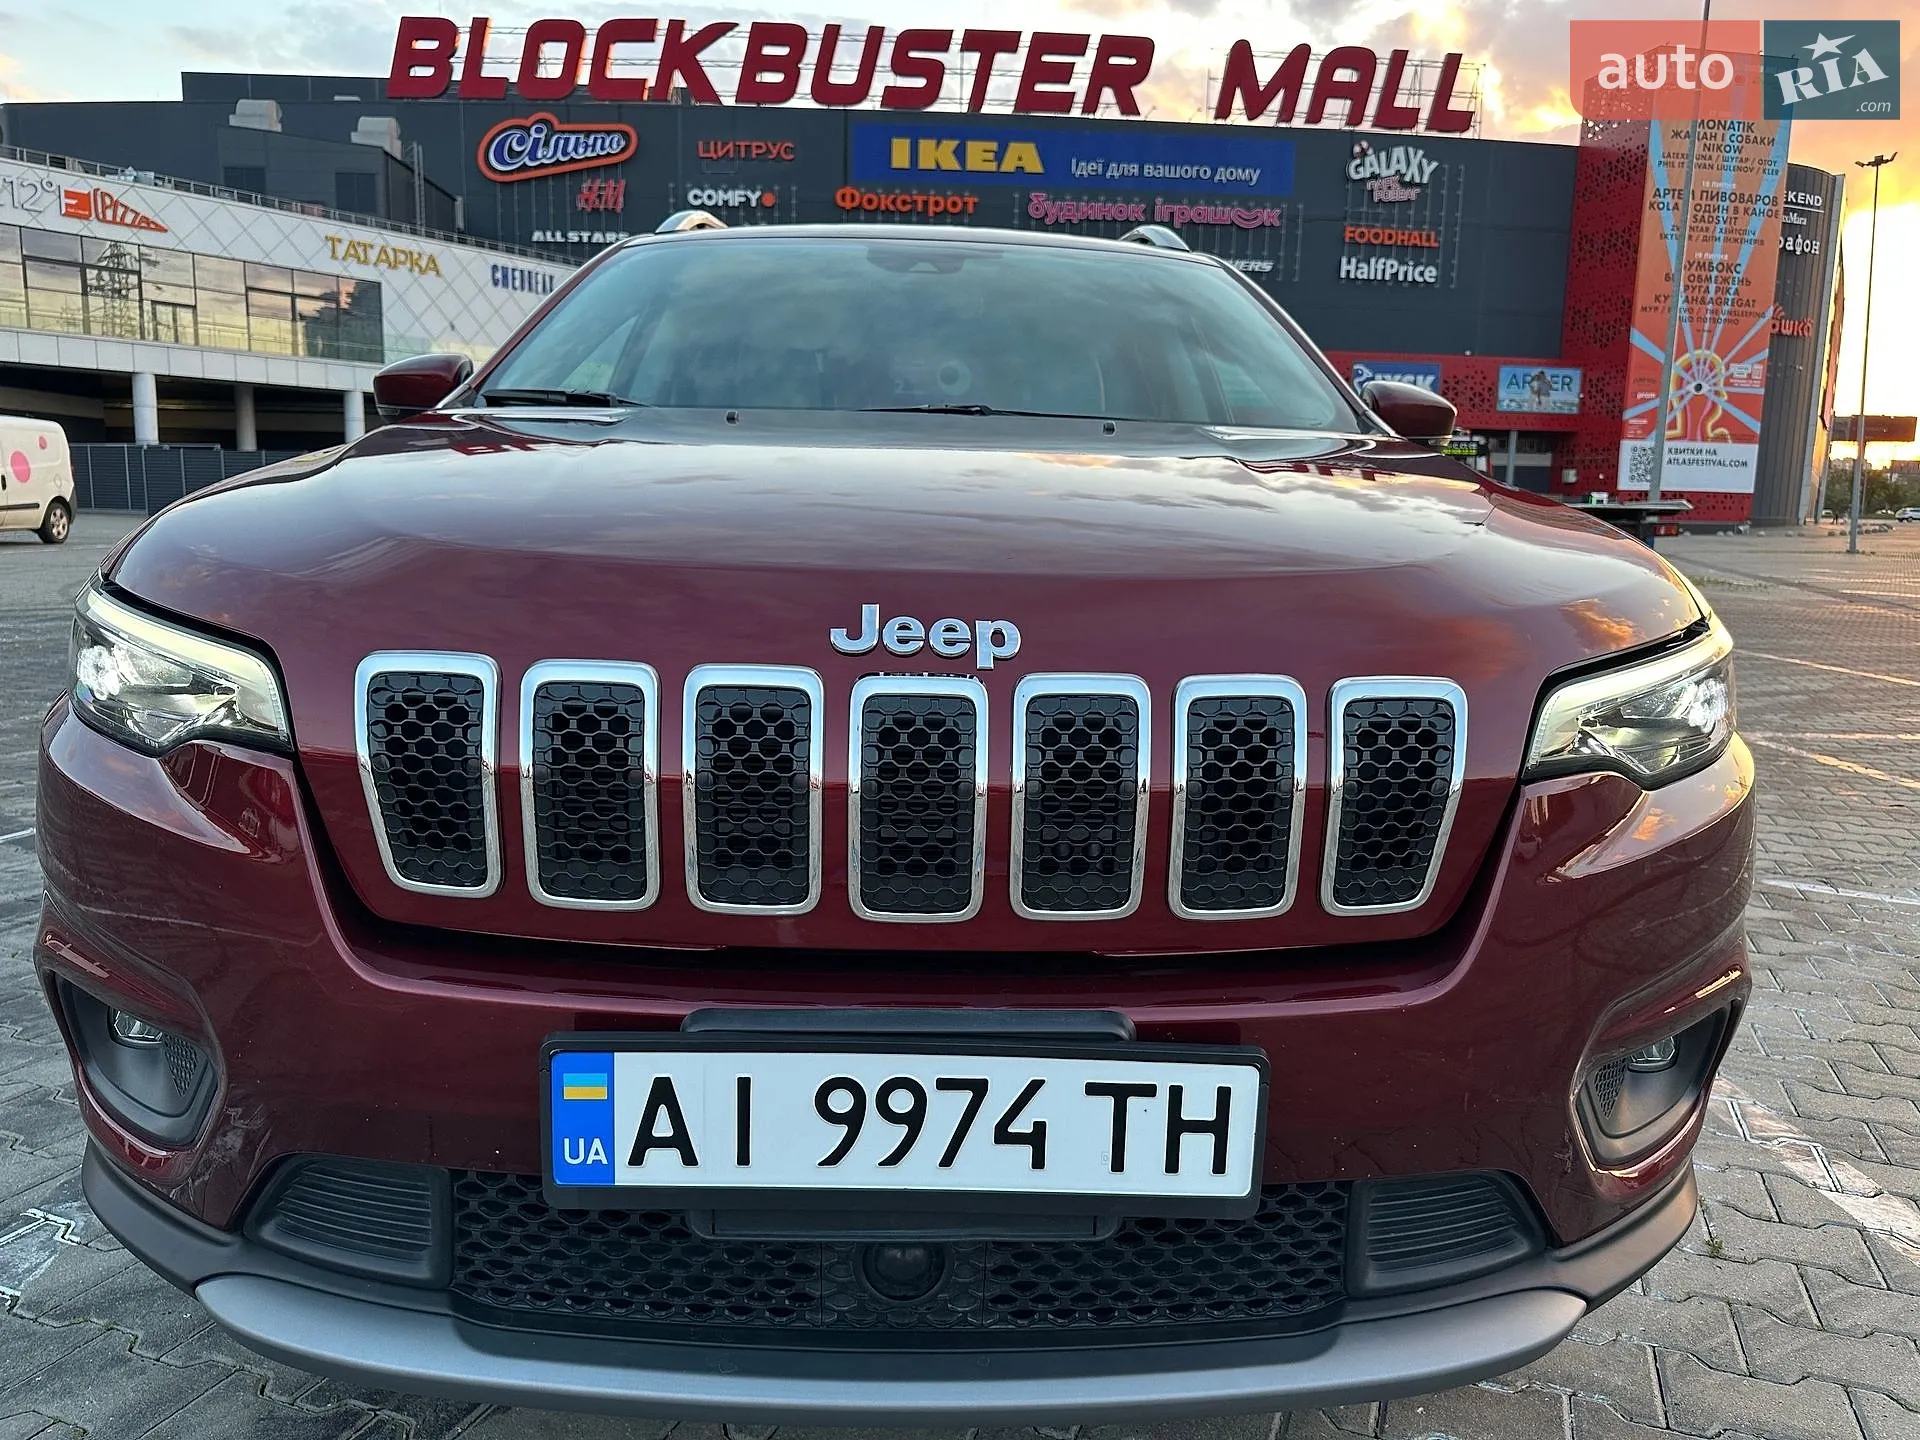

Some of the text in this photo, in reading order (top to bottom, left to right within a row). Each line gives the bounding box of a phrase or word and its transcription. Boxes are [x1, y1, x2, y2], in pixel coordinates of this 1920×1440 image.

[387, 16, 1480, 133] BLOCKBUSTER MALL
[487, 122, 626, 171] Сільпо
[1671, 129, 1717, 141] ЖААН
[1729, 134, 1775, 147] СОБАКИ
[1702, 143, 1744, 155] NIKOW
[697, 139, 795, 161] ЦИТРУС
[890, 136, 1045, 174] IKEA
[1071, 157, 1261, 186] Ідеї для вашого дому
[1347, 145, 1440, 184] GALAXY
[687, 188, 762, 207] COMFY
[835, 186, 979, 217] Фокстрот
[1028, 192, 1145, 225] будинок
[1700, 190, 1778, 207] ПИВОВАРОВ
[1694, 204, 1729, 216] ОДИН
[1743, 207, 1780, 220] КАНОЕ
[532, 229, 630, 243] ALLSTARS
[1344, 225, 1440, 248] FOODHALL
[325, 234, 442, 277] ТАТАРКА
[1339, 254, 1438, 283] HalfPrice
[1685, 260, 1742, 275] УМБОКС
[1684, 284, 1710, 295] РУГА
[1687, 274, 1752, 287] ОБМЕЖЕНЬ
[1654, 293, 1756, 308] КУАН&AGREGAT
[1506, 373, 1573, 393] ARER
[1667, 447, 1717, 457] КВИТКИ НА
[830, 603, 1022, 669] Jeep
[627, 1075, 1233, 1175] AI 9974 TH
[563, 1137, 608, 1166] UA
